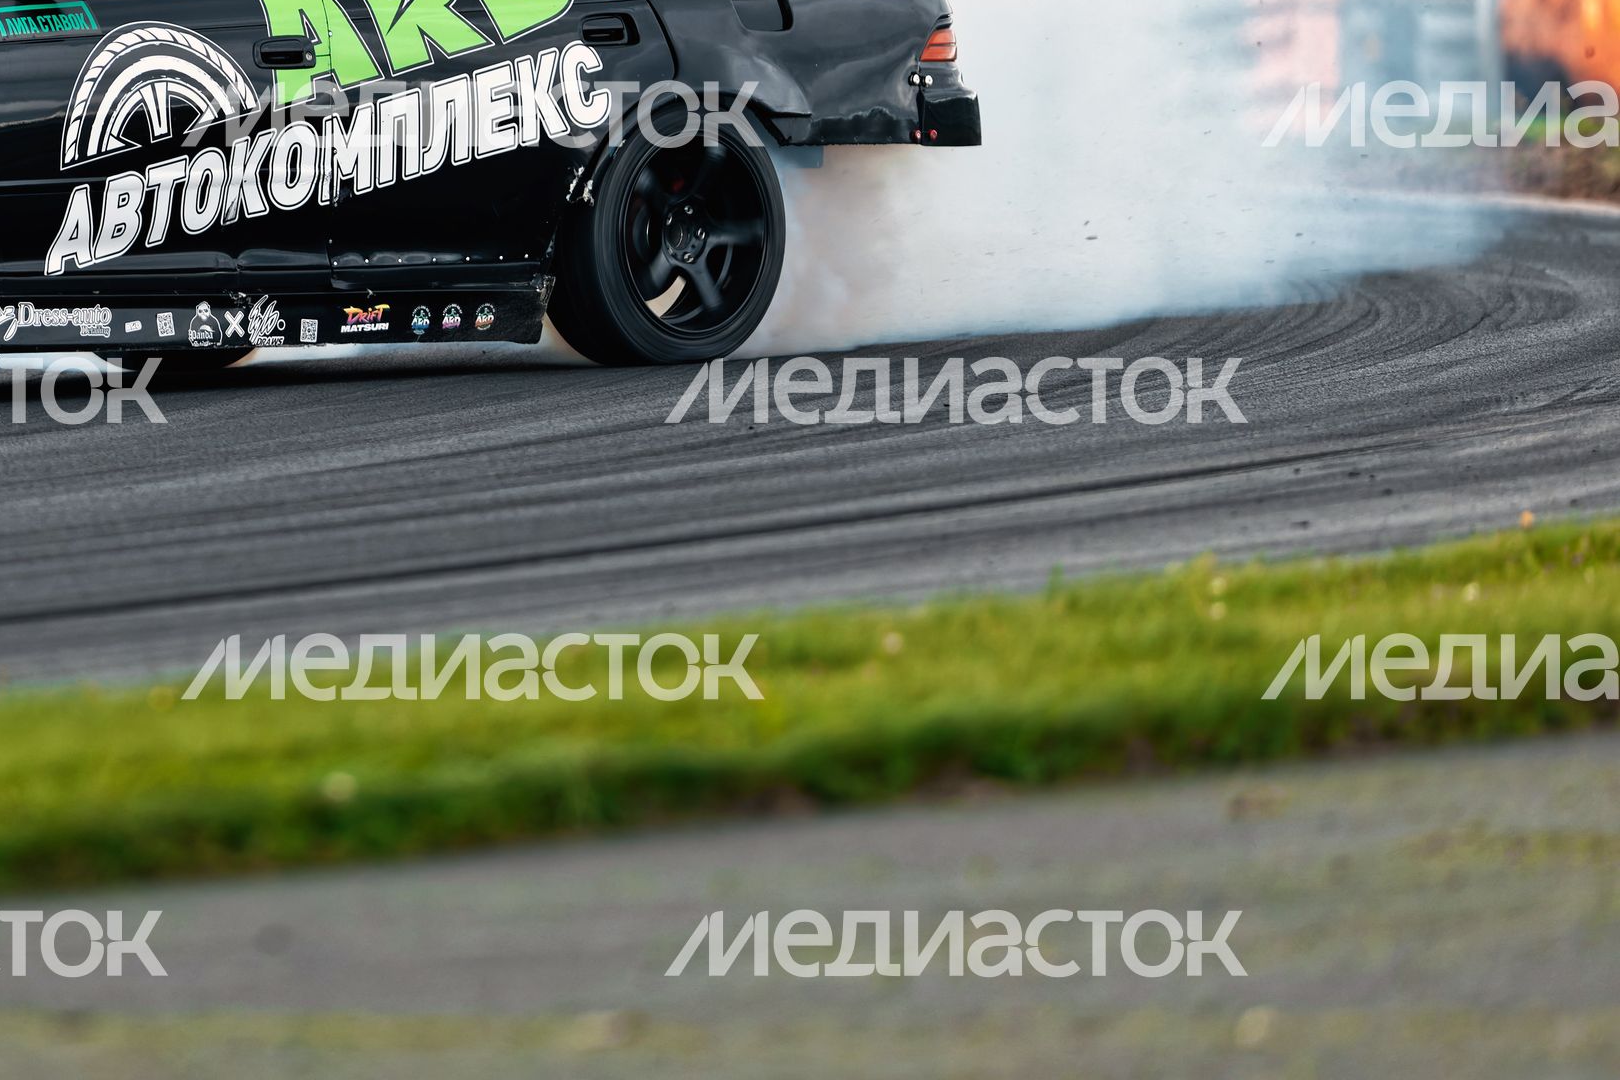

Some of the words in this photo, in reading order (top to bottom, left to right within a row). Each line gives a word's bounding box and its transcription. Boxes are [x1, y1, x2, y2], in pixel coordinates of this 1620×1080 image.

[5, 16, 40, 36] ЛИГА
[37, 12, 90, 33] СТАВОК
[44, 40, 613, 277] АВТОКОМПЛЕКС
[18, 302, 112, 327] Dress-auto
[340, 322, 389, 333] MATSURI
